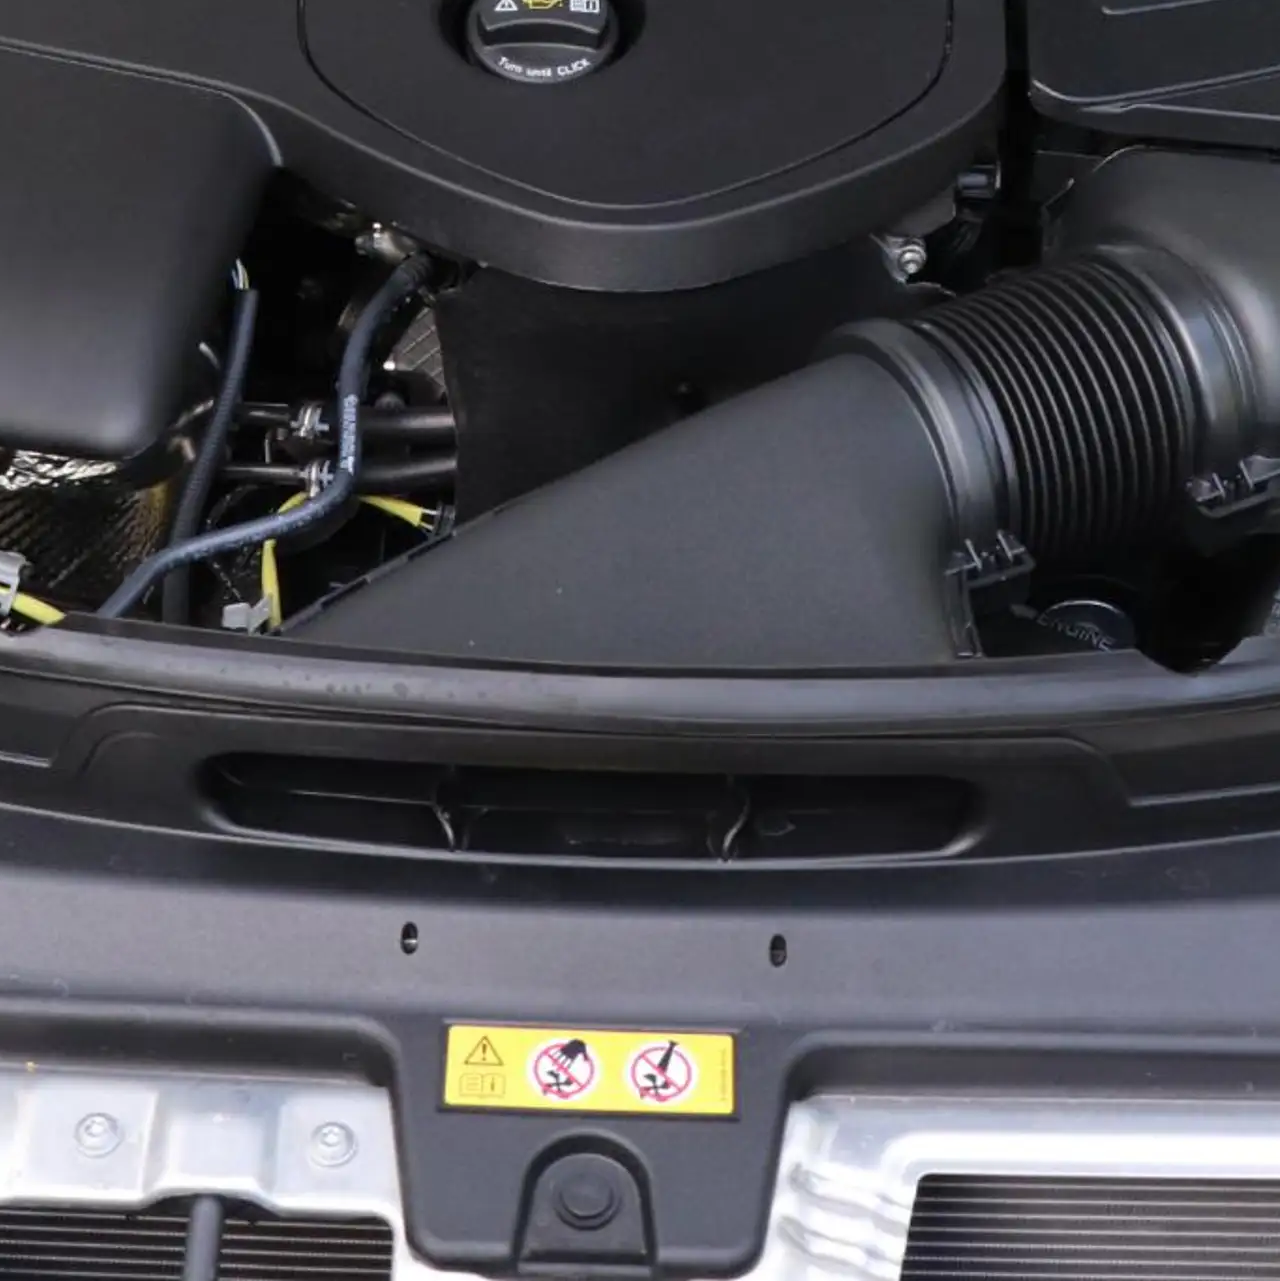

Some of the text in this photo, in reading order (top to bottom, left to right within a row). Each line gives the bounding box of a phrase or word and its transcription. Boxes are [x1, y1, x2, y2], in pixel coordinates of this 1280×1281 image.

[498, 56, 592, 77] Turn until CLICK
